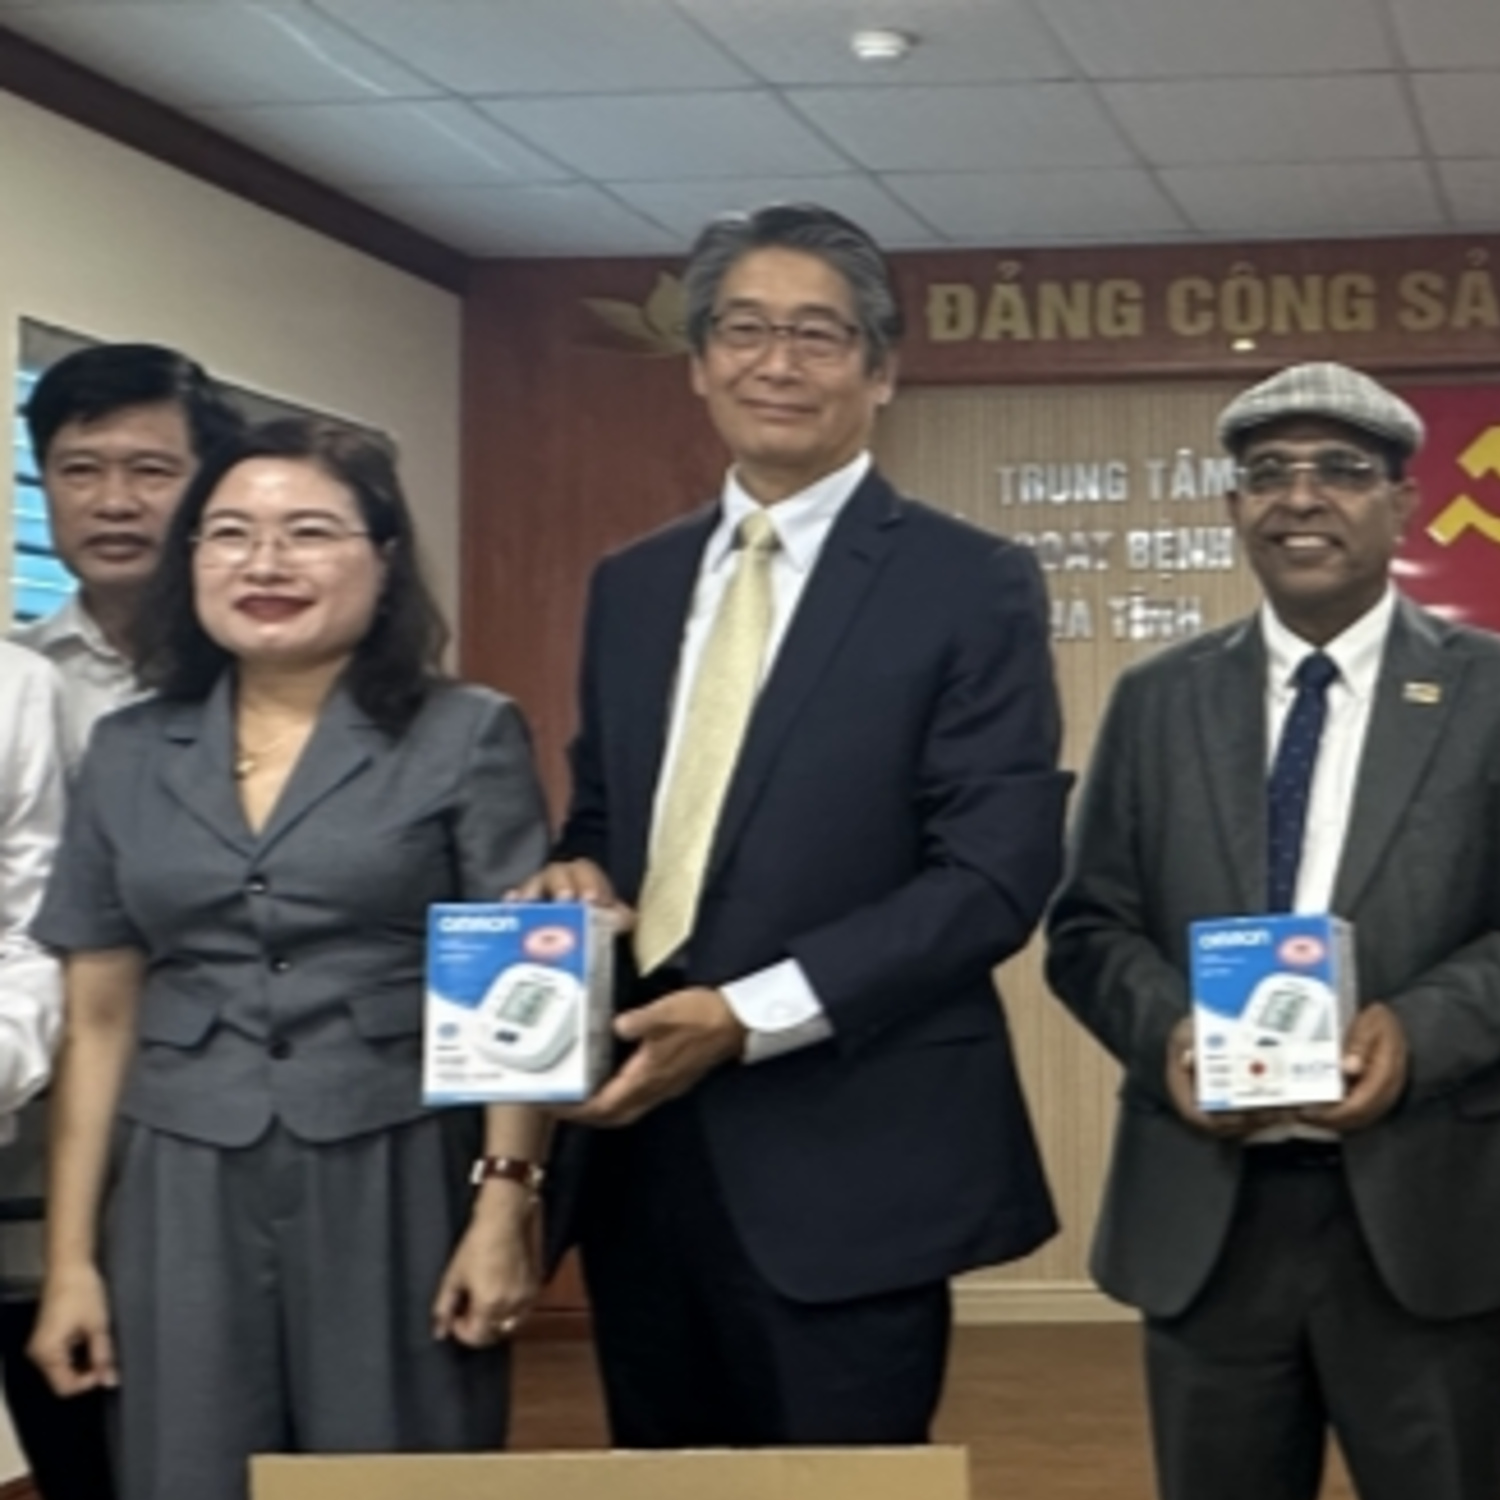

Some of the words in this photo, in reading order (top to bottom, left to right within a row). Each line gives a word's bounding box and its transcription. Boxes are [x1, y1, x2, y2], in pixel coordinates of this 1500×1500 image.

[926, 260, 1145, 342] ĐẢNG
[1166, 261, 1377, 351] CỘNG
[996, 461, 1127, 505] TRUNG
[1144, 447, 1235, 500] TÂM
